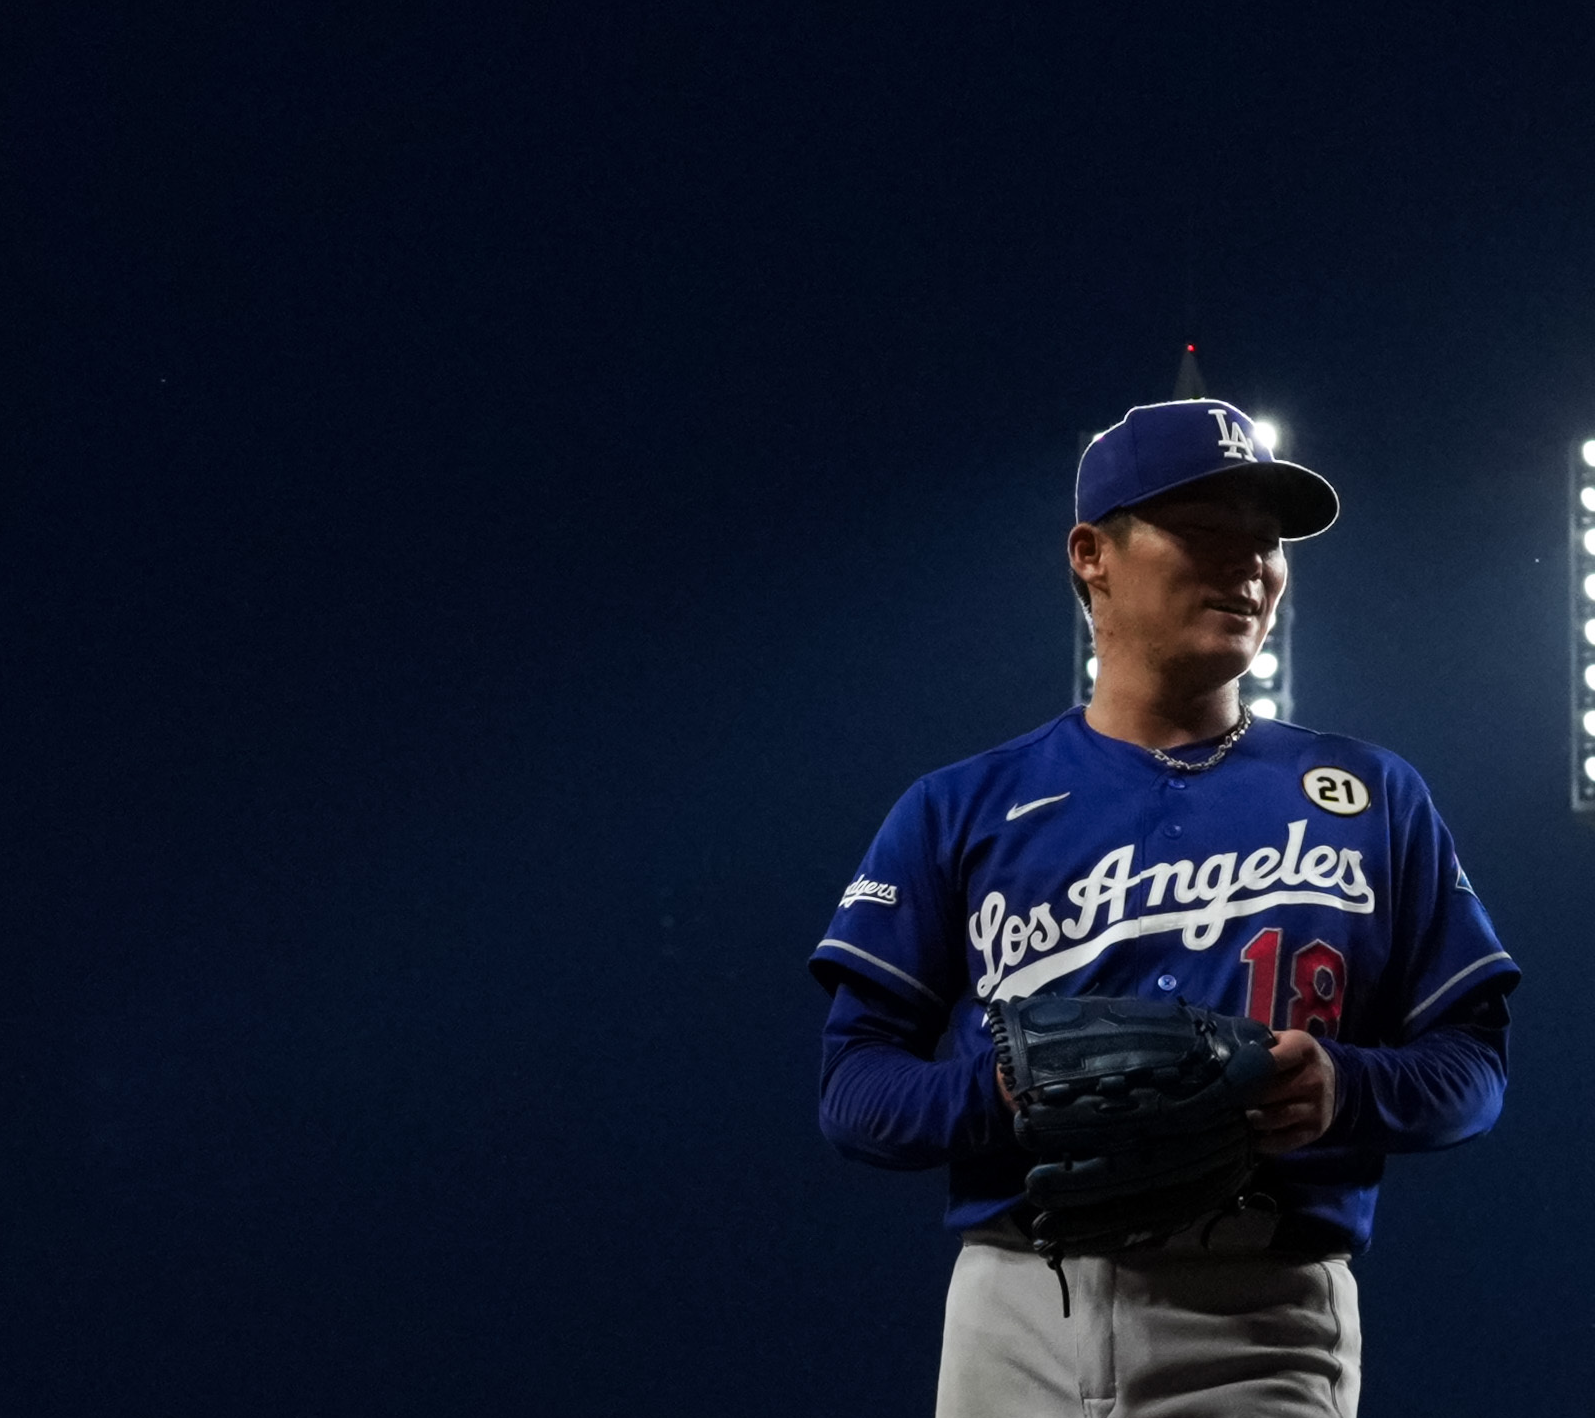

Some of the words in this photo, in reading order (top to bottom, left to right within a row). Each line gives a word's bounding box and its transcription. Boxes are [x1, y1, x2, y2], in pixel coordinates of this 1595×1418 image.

[1207, 408, 1259, 463] LA
[1316, 776, 1356, 805] 21
[968, 890, 1061, 998] Los
[1061, 818, 1373, 951] Angeles
[1240, 927, 1348, 1041] 18
